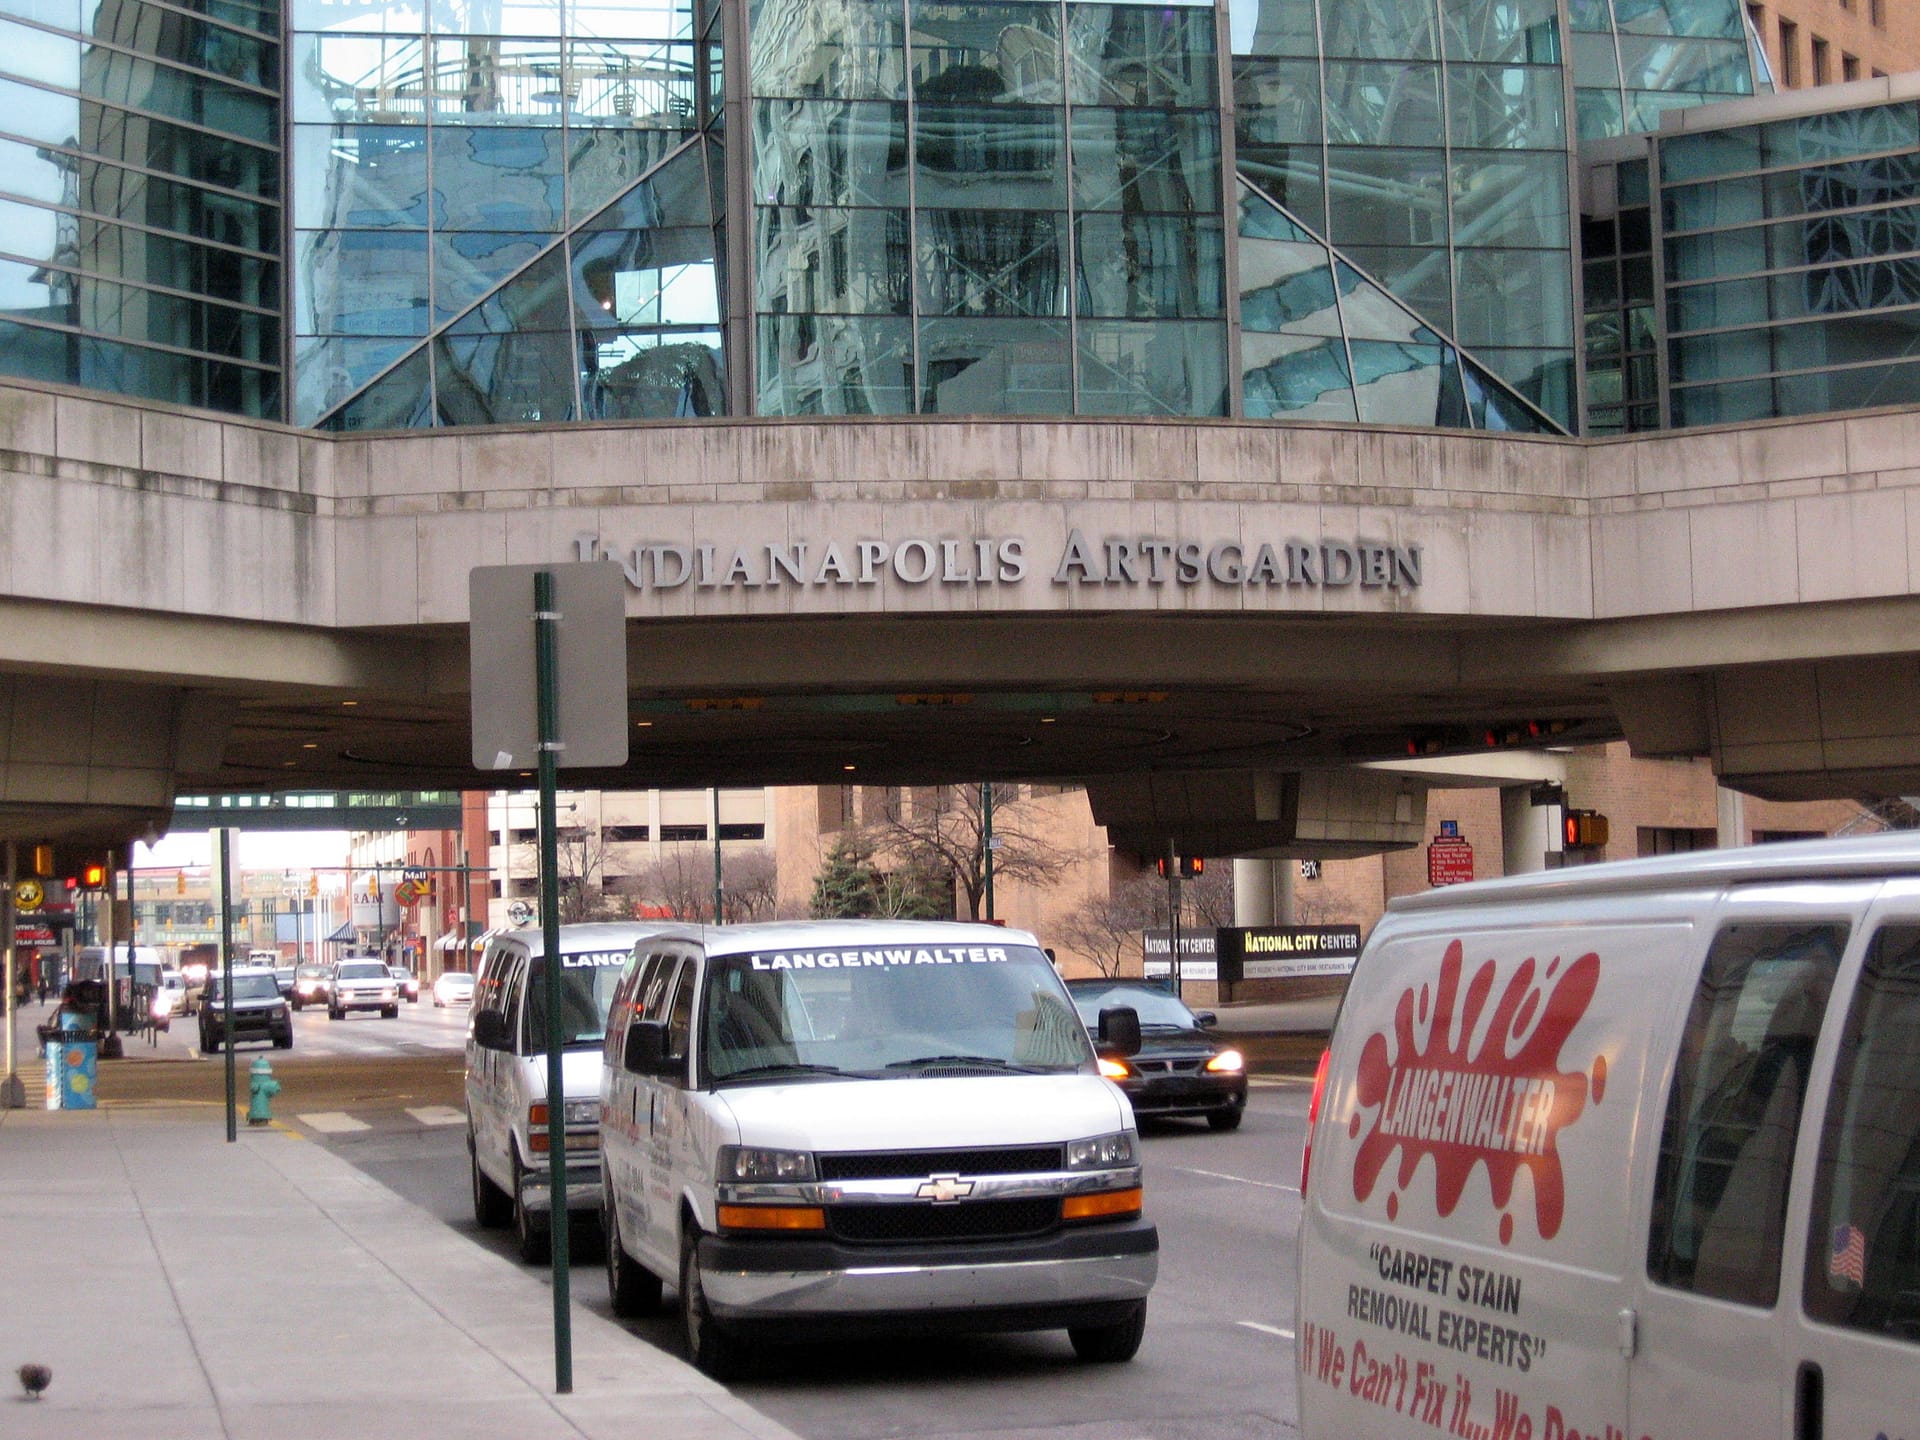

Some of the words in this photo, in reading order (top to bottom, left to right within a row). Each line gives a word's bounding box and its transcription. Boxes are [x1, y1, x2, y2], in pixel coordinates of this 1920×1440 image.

[1052, 528, 1424, 588] ARTSGARDEN
[404, 870, 427, 880] Mall
[353, 892, 385, 905] RAM
[751, 948, 1008, 970] LANGENWALTER
[1144, 935, 1172, 953] NATIONA
[1190, 938, 1216, 953] CENTER
[1245, 931, 1294, 952] NATIONAL
[1295, 935, 1318, 951] CITY
[1320, 934, 1357, 949] CENTER
[1380, 1067, 1555, 1157] LANGENWALTER
[1457, 1264, 1521, 1315] STAIN
[1347, 1284, 1432, 1342] REMOVAL
[1318, 1328, 1346, 1389] We
[1350, 1339, 1408, 1413] Can't
[1409, 1360, 1448, 1429] Fix
